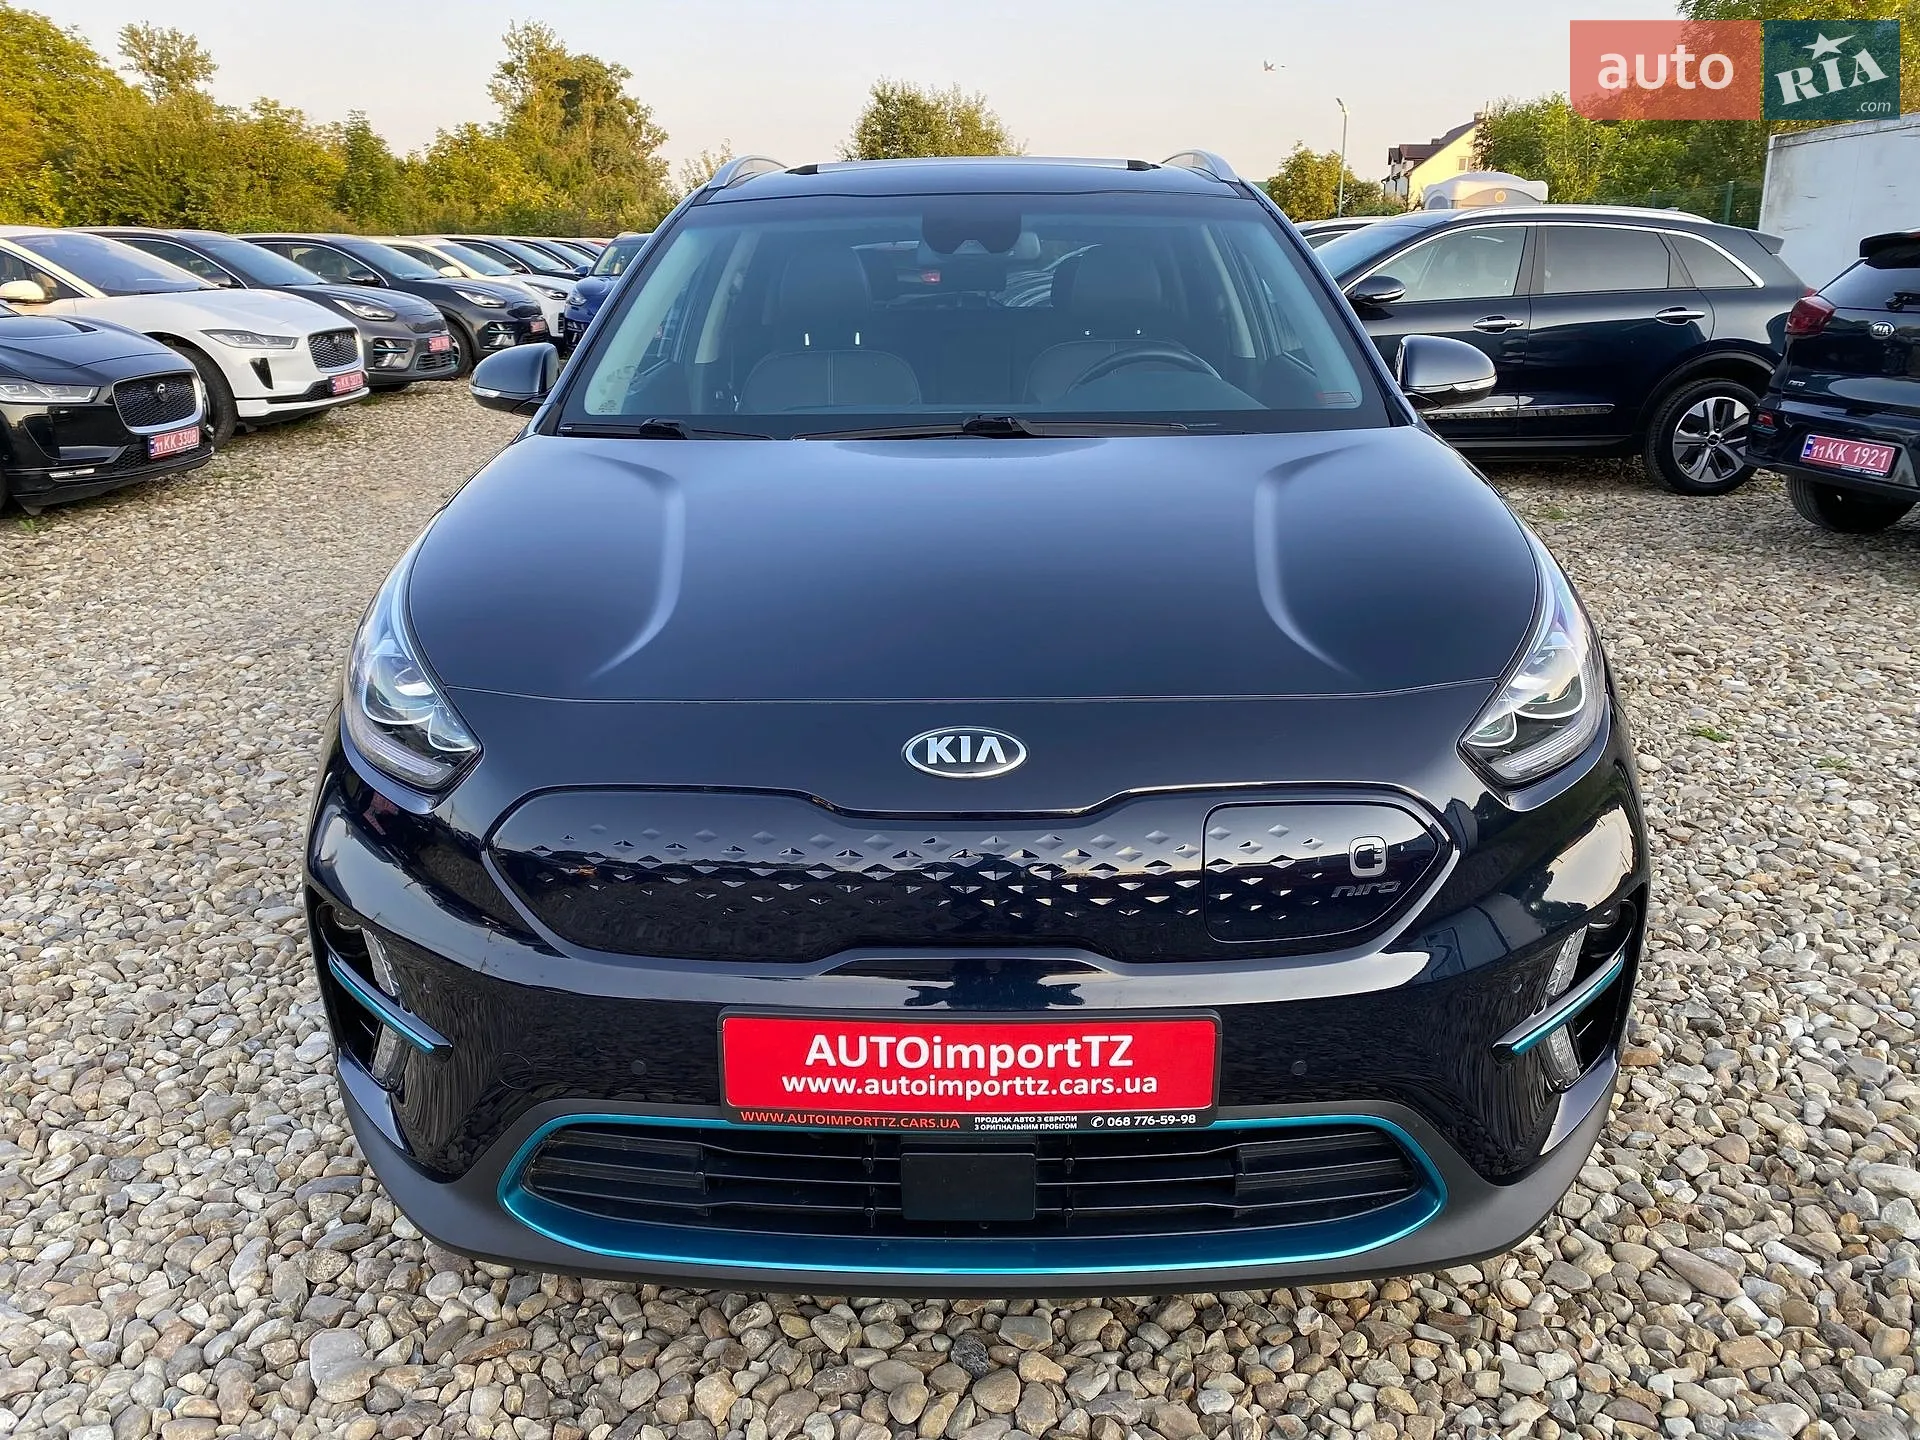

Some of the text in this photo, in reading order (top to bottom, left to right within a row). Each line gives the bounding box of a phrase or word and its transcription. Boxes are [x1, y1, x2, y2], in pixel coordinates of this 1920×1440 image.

[1853, 446, 1889, 469] 1921
[926, 735, 1007, 765] KIA
[804, 1034, 1134, 1077] AUTOimportTZ
[781, 1074, 1158, 1102] www.autoimporttz.cars.ua
[740, 1111, 961, 1129] WWW.AUTOIMPORTTZ.CARS.UA
[974, 1116, 1012, 1124] ПРОДАЖ
[1107, 1114, 1197, 1127] 068 776-59-98
